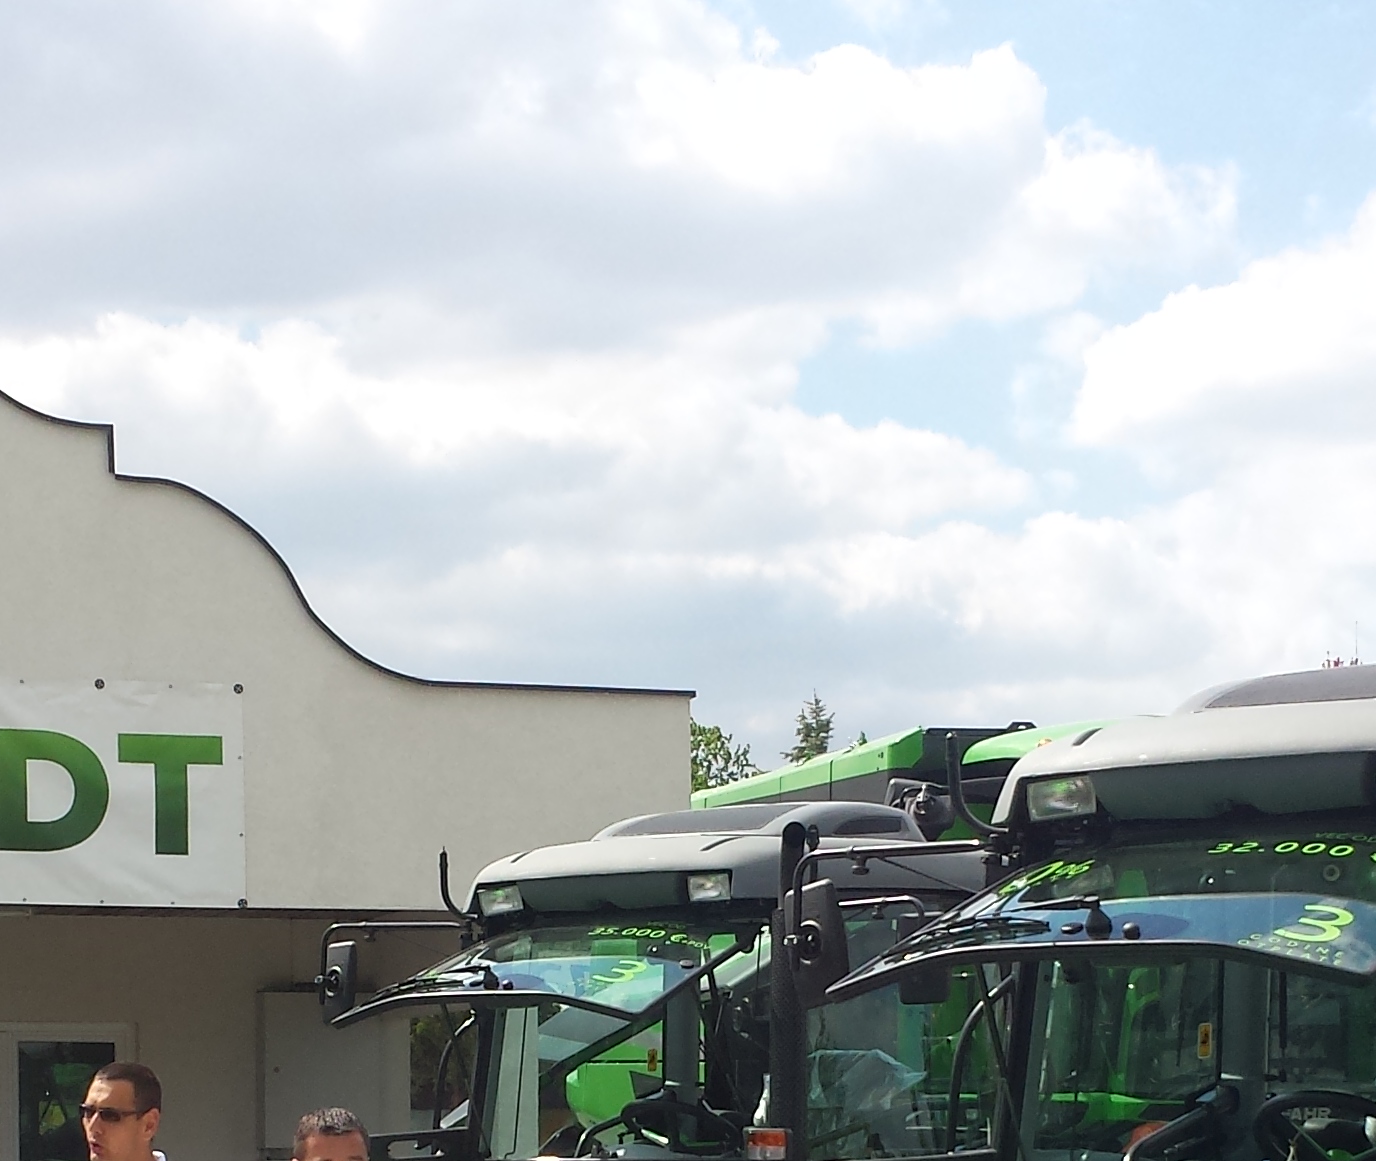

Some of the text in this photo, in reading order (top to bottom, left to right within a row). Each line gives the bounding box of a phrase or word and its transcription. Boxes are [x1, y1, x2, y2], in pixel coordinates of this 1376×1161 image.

[1208, 840, 1355, 857] 32.000
[1274, 904, 1355, 943] 3
[591, 959, 648, 984] 3
